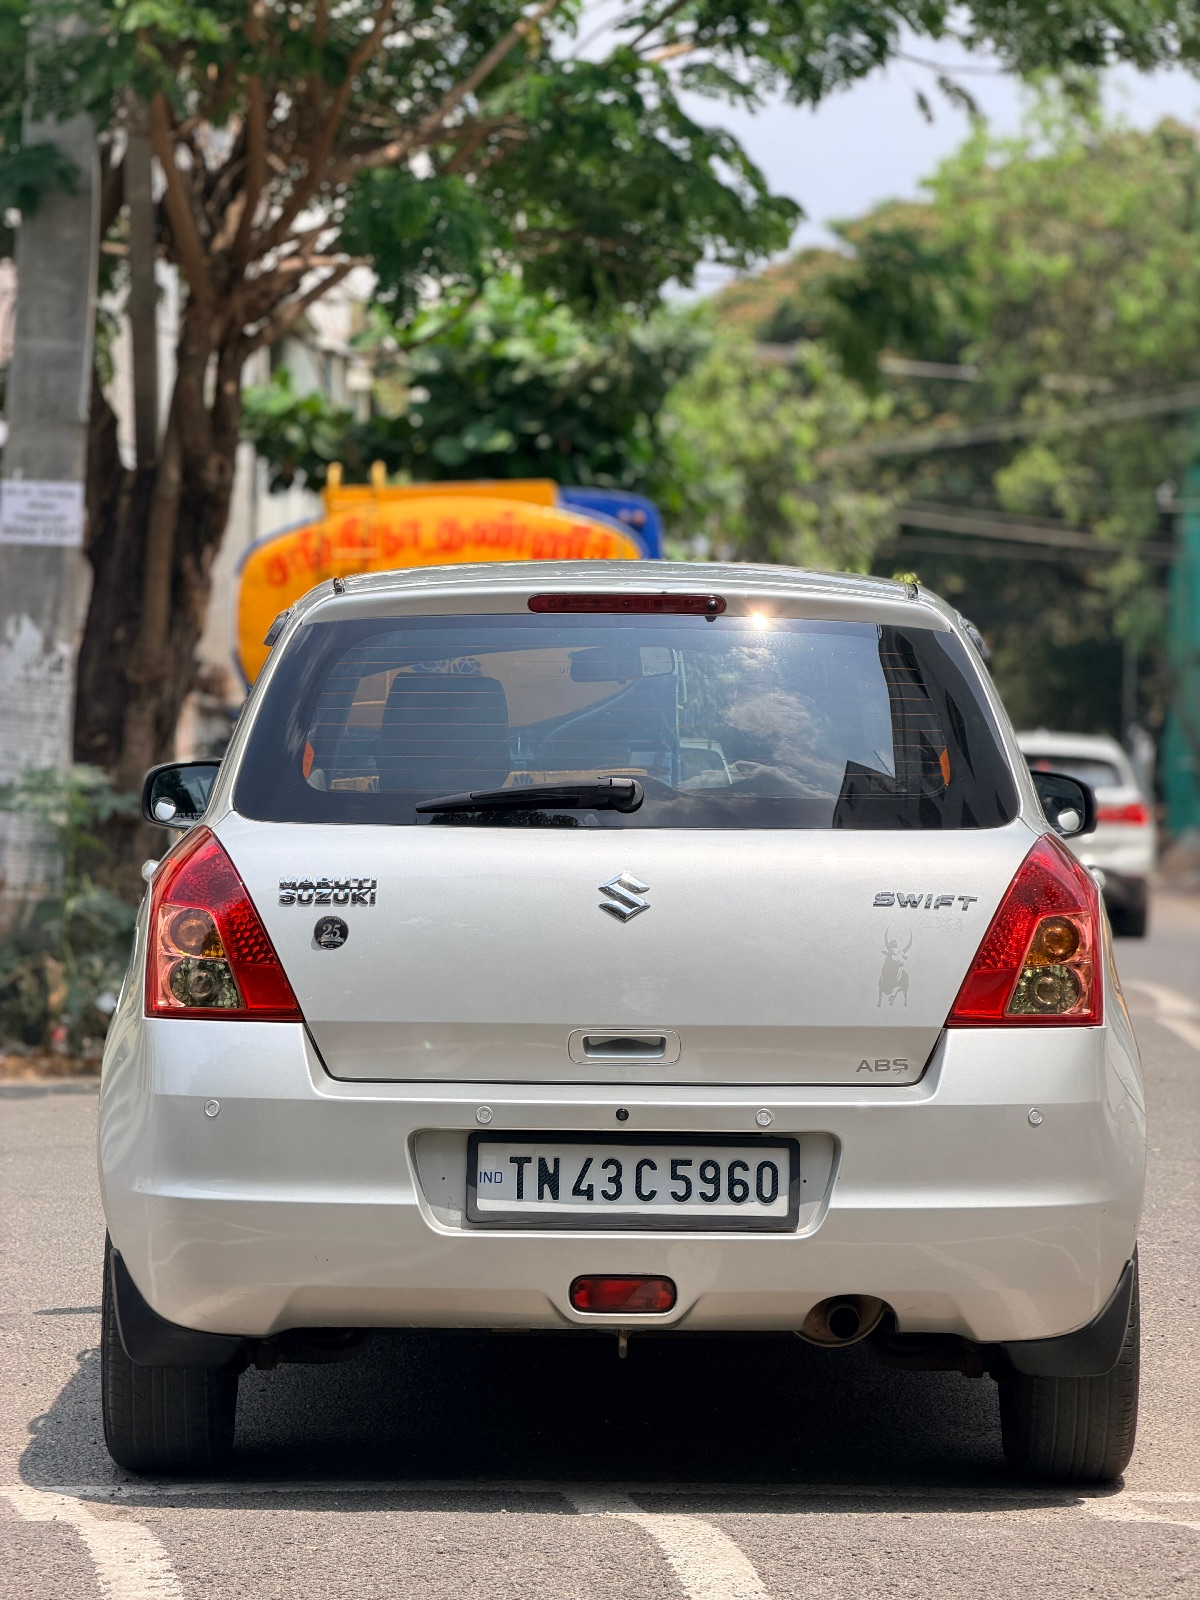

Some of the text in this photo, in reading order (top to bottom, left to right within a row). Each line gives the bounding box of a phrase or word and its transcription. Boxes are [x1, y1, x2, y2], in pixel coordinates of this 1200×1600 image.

[279, 876, 378, 889] MARUTI
[279, 888, 376, 905] SUZUKI
[872, 891, 979, 911] SWIFT
[322, 923, 342, 938] 25
[855, 1058, 909, 1073] ABS
[478, 1171, 503, 1185] IND
[509, 1156, 779, 1204] TN 43 C 5960
